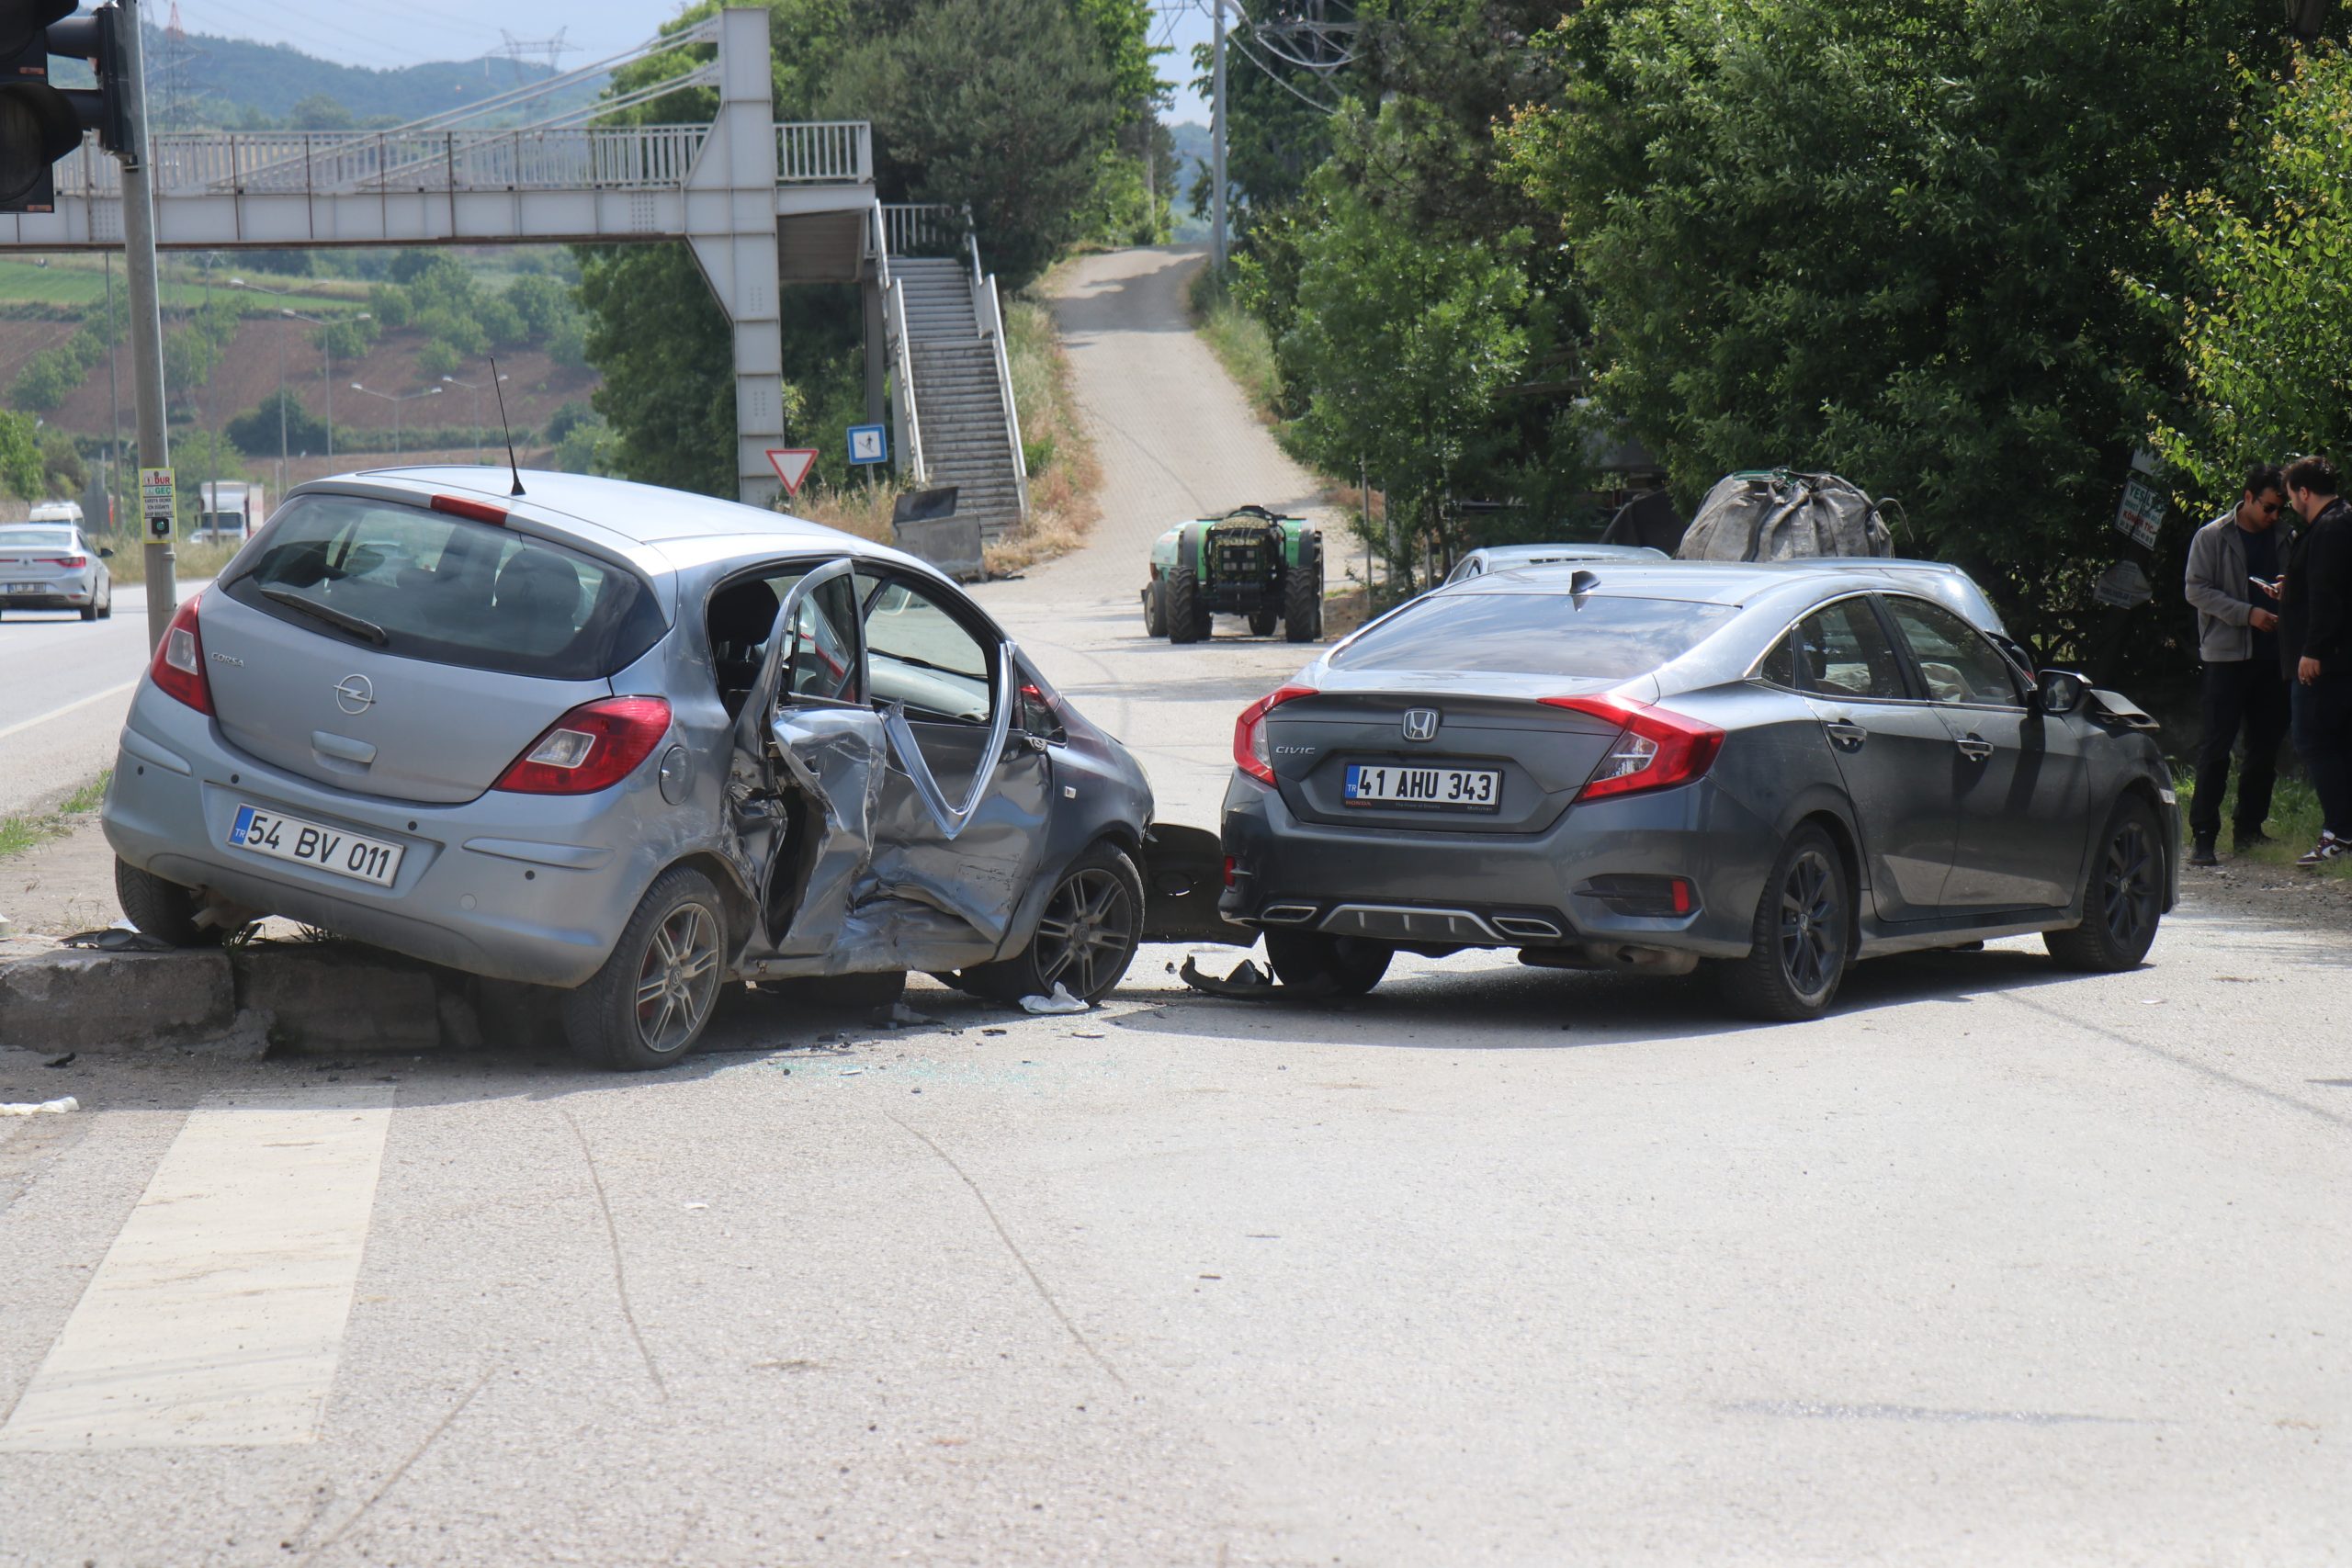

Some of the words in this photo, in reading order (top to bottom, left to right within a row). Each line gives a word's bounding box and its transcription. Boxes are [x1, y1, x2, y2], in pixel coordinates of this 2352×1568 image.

[155, 487, 171, 495] GEÇ
[211, 652, 244, 667] CORSA
[1275, 746, 1316, 754] CIVIC
[1347, 784, 1357, 793] TR
[1359, 769, 1385, 796] 41
[1396, 771, 1439, 798] AHU
[1447, 773, 1492, 801] 343
[234, 829, 245, 839] TR
[248, 815, 283, 850] 54
[294, 827, 341, 863] BV
[347, 842, 390, 878] 011
